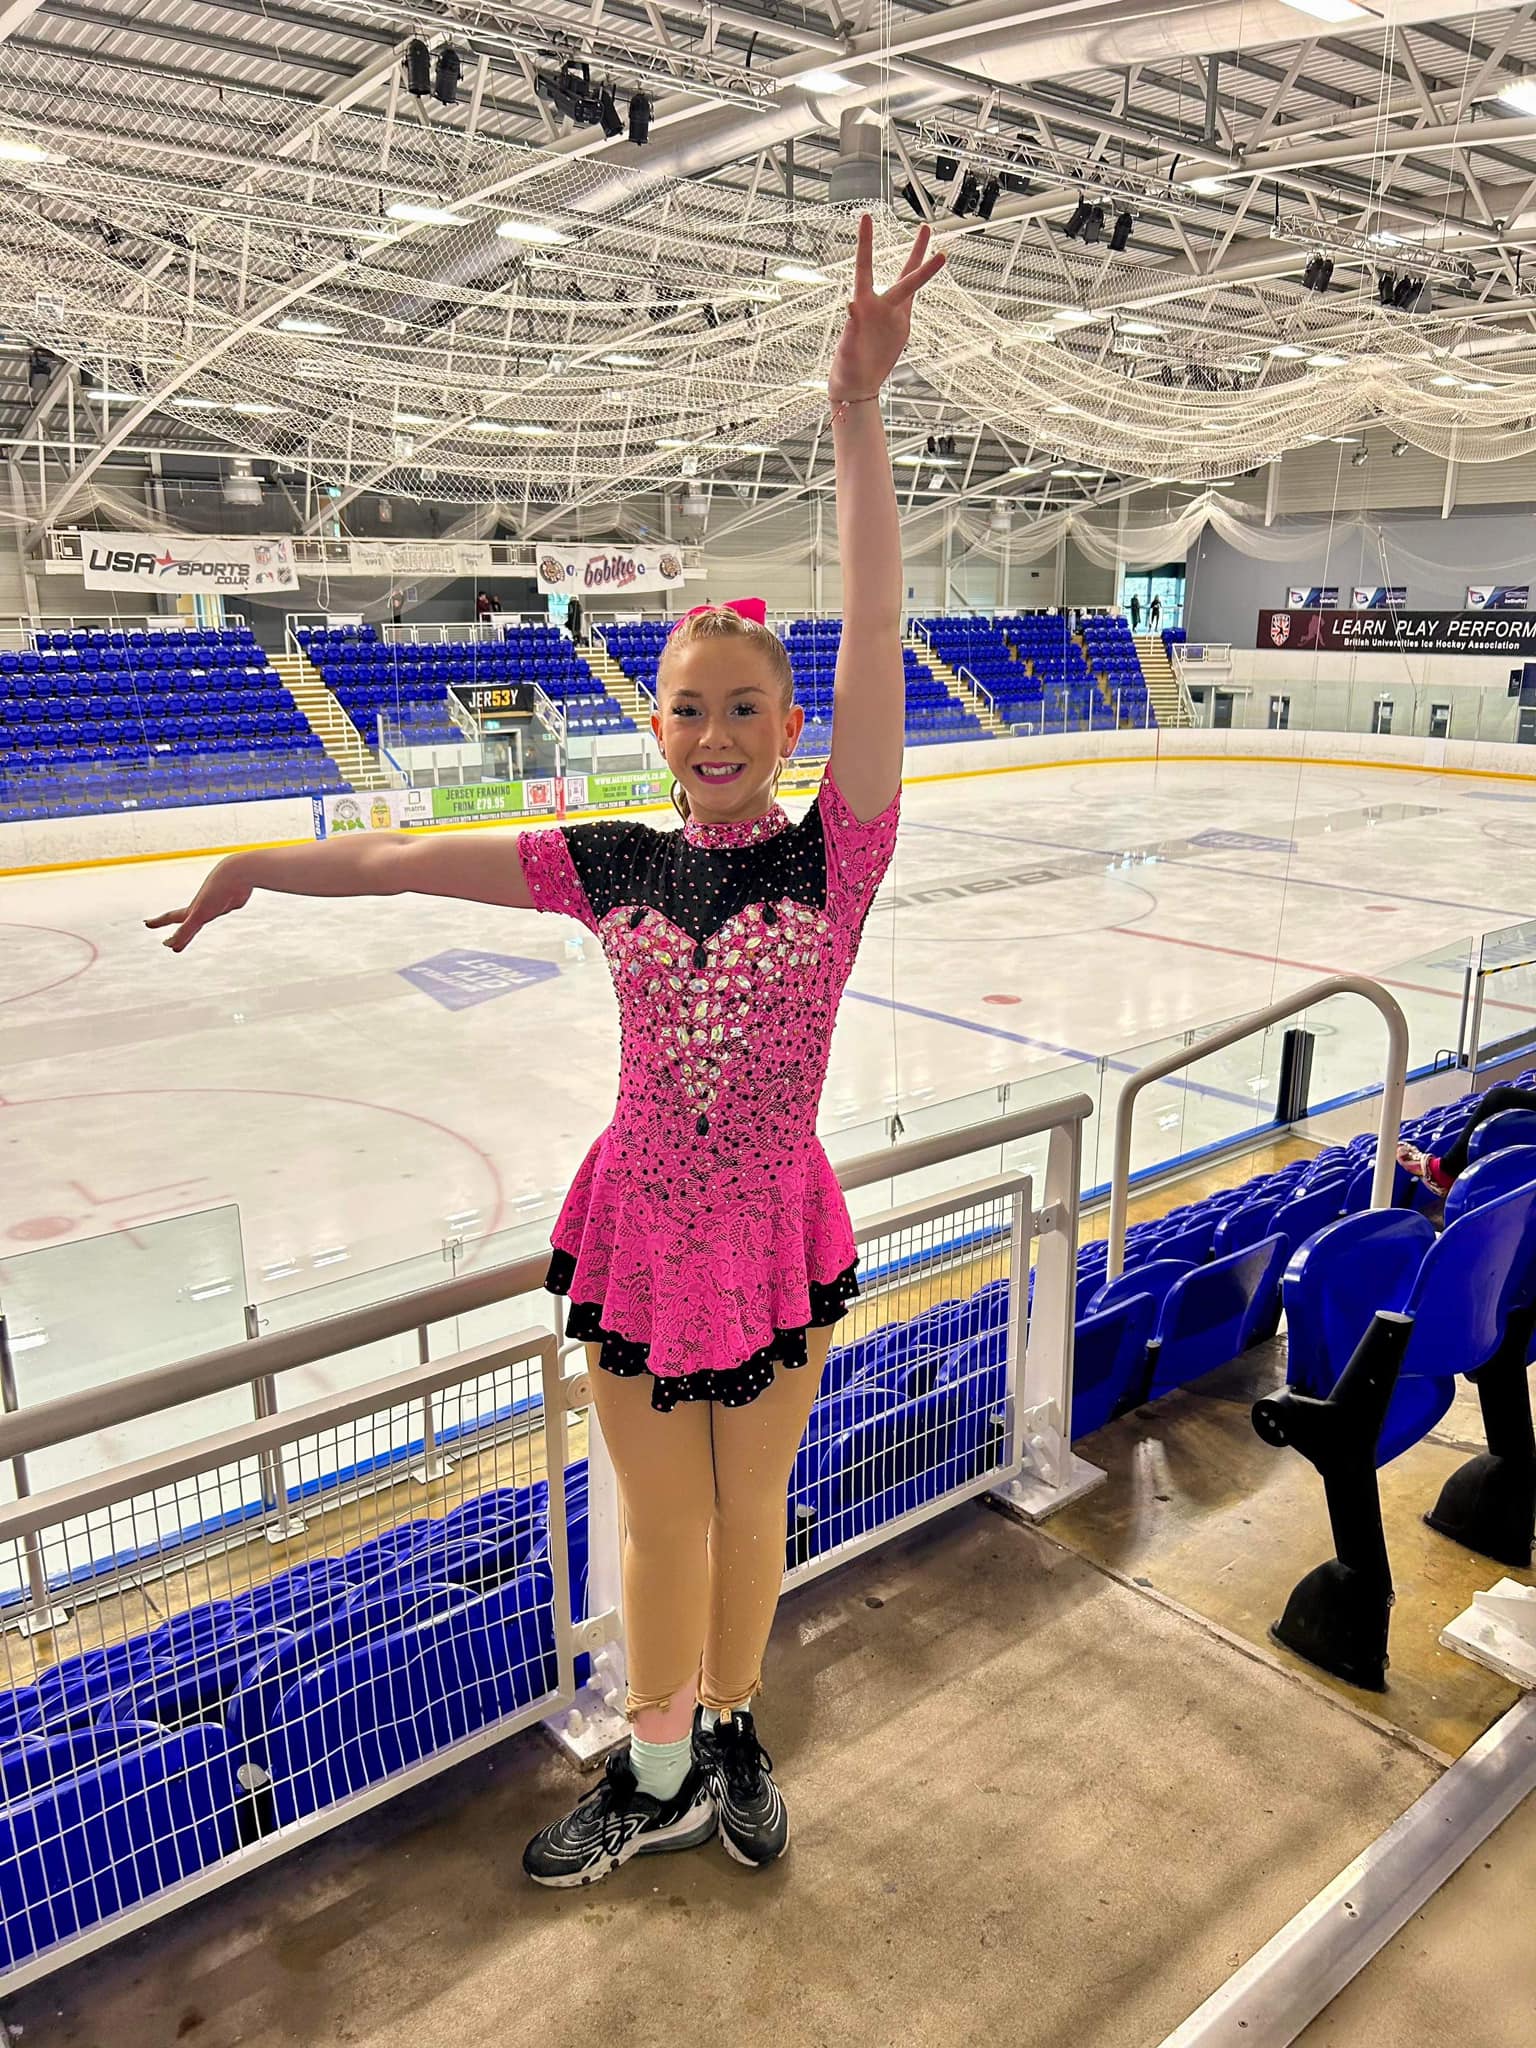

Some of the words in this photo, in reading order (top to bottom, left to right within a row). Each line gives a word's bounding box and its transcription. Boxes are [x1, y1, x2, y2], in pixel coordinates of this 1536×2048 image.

[89, 549, 157, 574] USA
[177, 561, 251, 577] SPORTS
[1332, 619, 1386, 636] LEARN
[1395, 620, 1439, 636] PLAY
[1447, 620, 1536, 638] PERFORM
[1344, 638, 1370, 647] British
[1372, 638, 1419, 648] Universities
[1421, 639, 1434, 648] Ice
[1436, 640, 1466, 650] Hockey
[1468, 640, 1520, 650] Association
[468, 689, 518, 708] JER53Y
[446, 788, 475, 800] JERSEY
[477, 785, 511, 797] FRAMING
[453, 801, 475, 812] FROM
